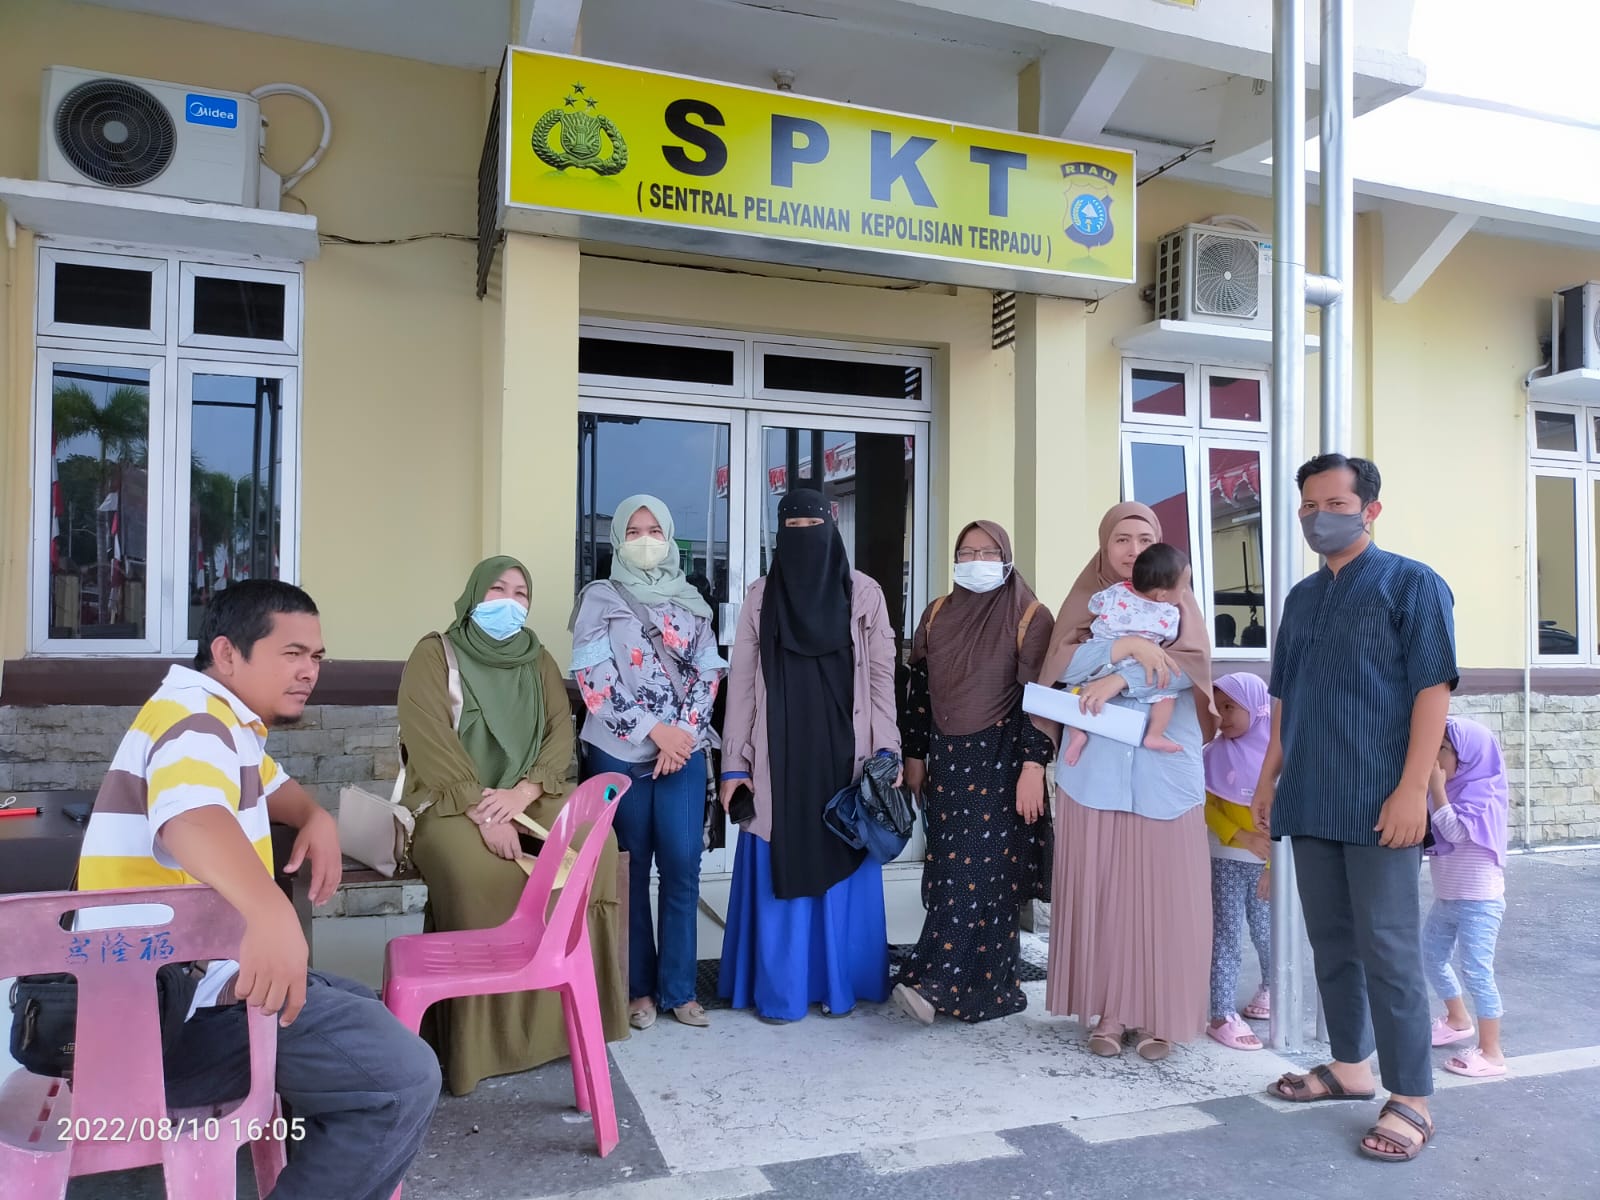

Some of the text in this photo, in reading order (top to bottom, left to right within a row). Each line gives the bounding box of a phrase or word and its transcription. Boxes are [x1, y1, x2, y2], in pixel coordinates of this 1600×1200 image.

[190, 101, 234, 120] Midea
[1064, 164, 1112, 181] RIAU
[744, 196, 850, 232] PELAYANAN
[861, 211, 964, 247] KEPOLISIAN
